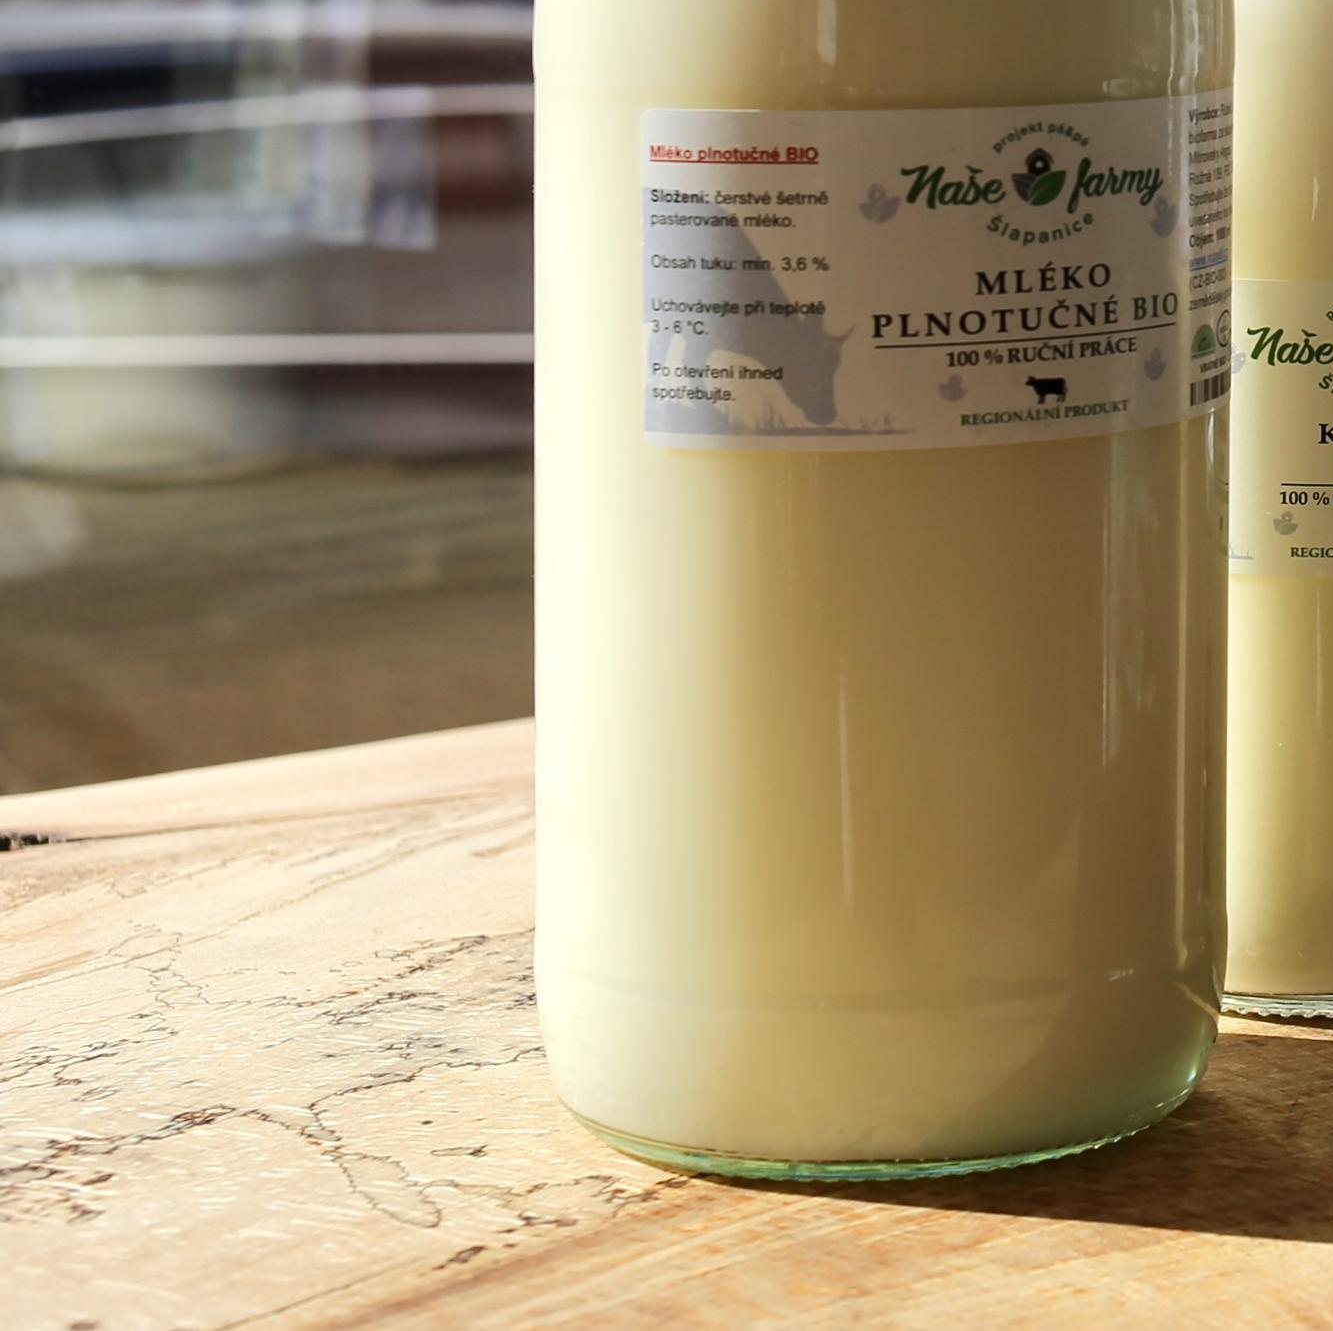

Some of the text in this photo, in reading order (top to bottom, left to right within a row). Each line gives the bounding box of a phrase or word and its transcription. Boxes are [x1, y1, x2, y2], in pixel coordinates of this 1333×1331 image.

[993, 122, 1043, 154] projekt
[650, 145, 819, 162] Mléko plnotučné BIO
[900, 164, 1006, 210] Naše
[1067, 157, 1163, 215] farmy
[650, 188, 829, 205] Složení: čerstvé šetrně
[650, 213, 797, 228] pasterované mléko.
[986, 213, 1095, 246] Šlapanice
[650, 254, 830, 273] Obsah tuku: min. 3,6 %
[975, 261, 1111, 296] MLÉKO
[651, 298, 826, 317] Uchovávejte při teplotě
[871, 292, 1178, 339] PLNOTUČNÉ BIO
[652, 320, 682, 334] 3 6
[946, 335, 1137, 368] 100 % RUČNÍ PRÁCE
[652, 363, 784, 379] Po otevření ihned
[652, 385, 737, 404] spotřebujte.
[960, 399, 1130, 427] REGIONÁLNÍ PRODUKT
[1280, 490, 1308, 506] 100
[1312, 490, 1330, 506] %
